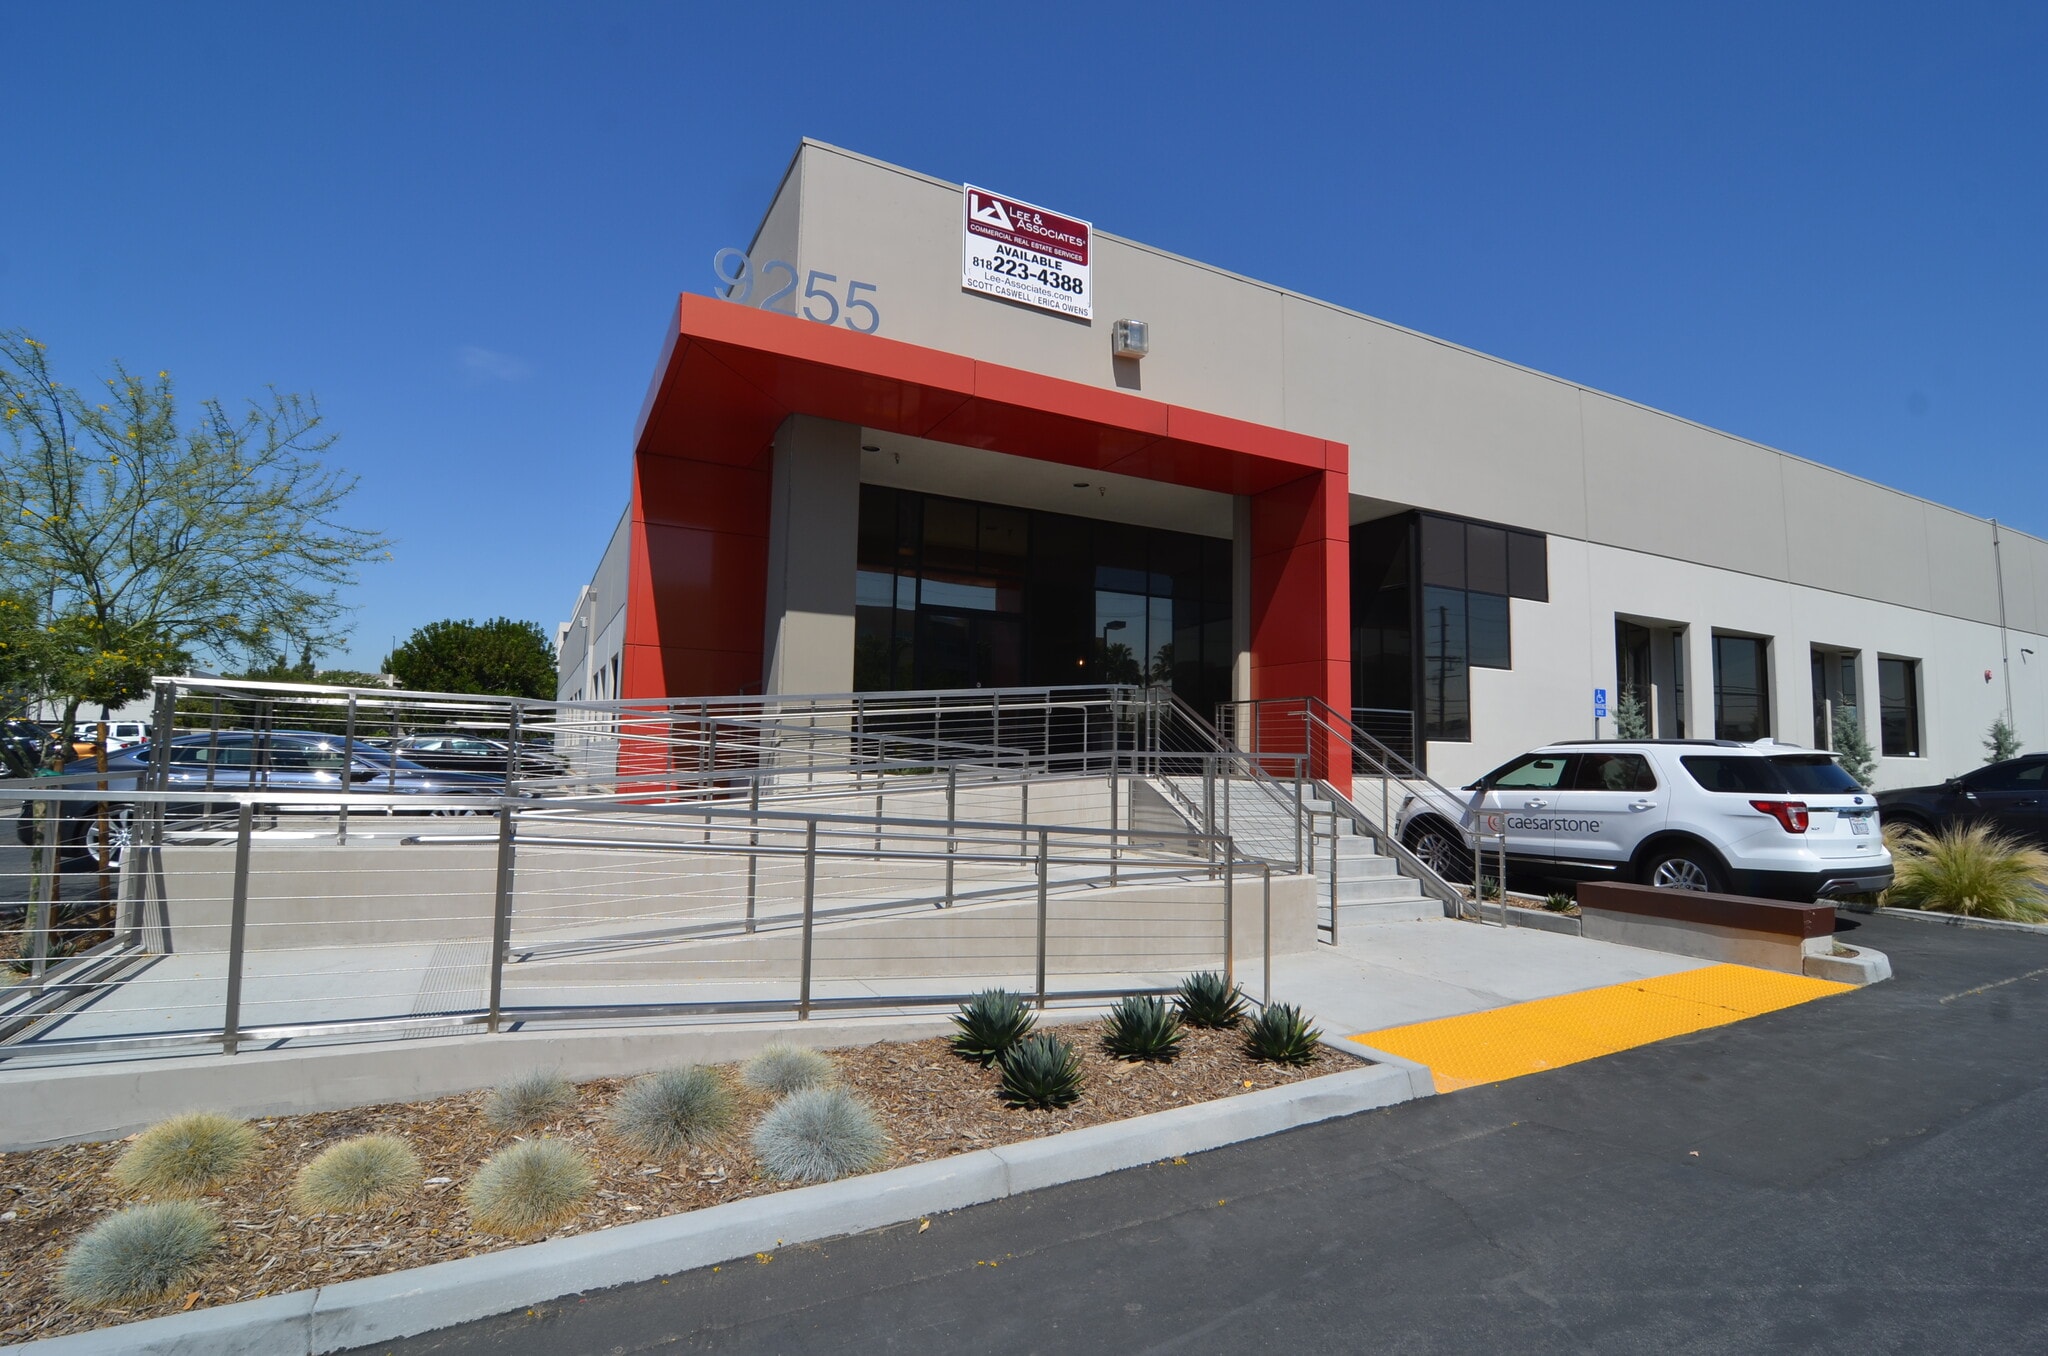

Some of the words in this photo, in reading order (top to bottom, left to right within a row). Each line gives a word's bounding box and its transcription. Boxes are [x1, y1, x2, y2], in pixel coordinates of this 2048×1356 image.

[1010, 206, 1030, 222] LEE
[1033, 214, 1043, 225] &
[970, 224, 1012, 242] COMMERCIAL
[1014, 236, 1030, 246] REAL
[1031, 242, 1053, 252] ESTATE
[1054, 248, 1083, 261] SERVICES
[1017, 220, 1083, 246] ASSOCIATES
[996, 244, 1062, 270] AVAILABLE
[972, 257, 992, 270] 818
[993, 256, 1083, 295] 223-4388
[984, 272, 1073, 302] Lee-Associates.com
[714, 247, 880, 335] 9255
[967, 278, 993, 291] SCOTT
[995, 285, 1031, 302] CASWELL
[1038, 297, 1060, 309] ERICA
[1062, 303, 1088, 316] OWENS
[1507, 817, 1600, 833] caesarstone
